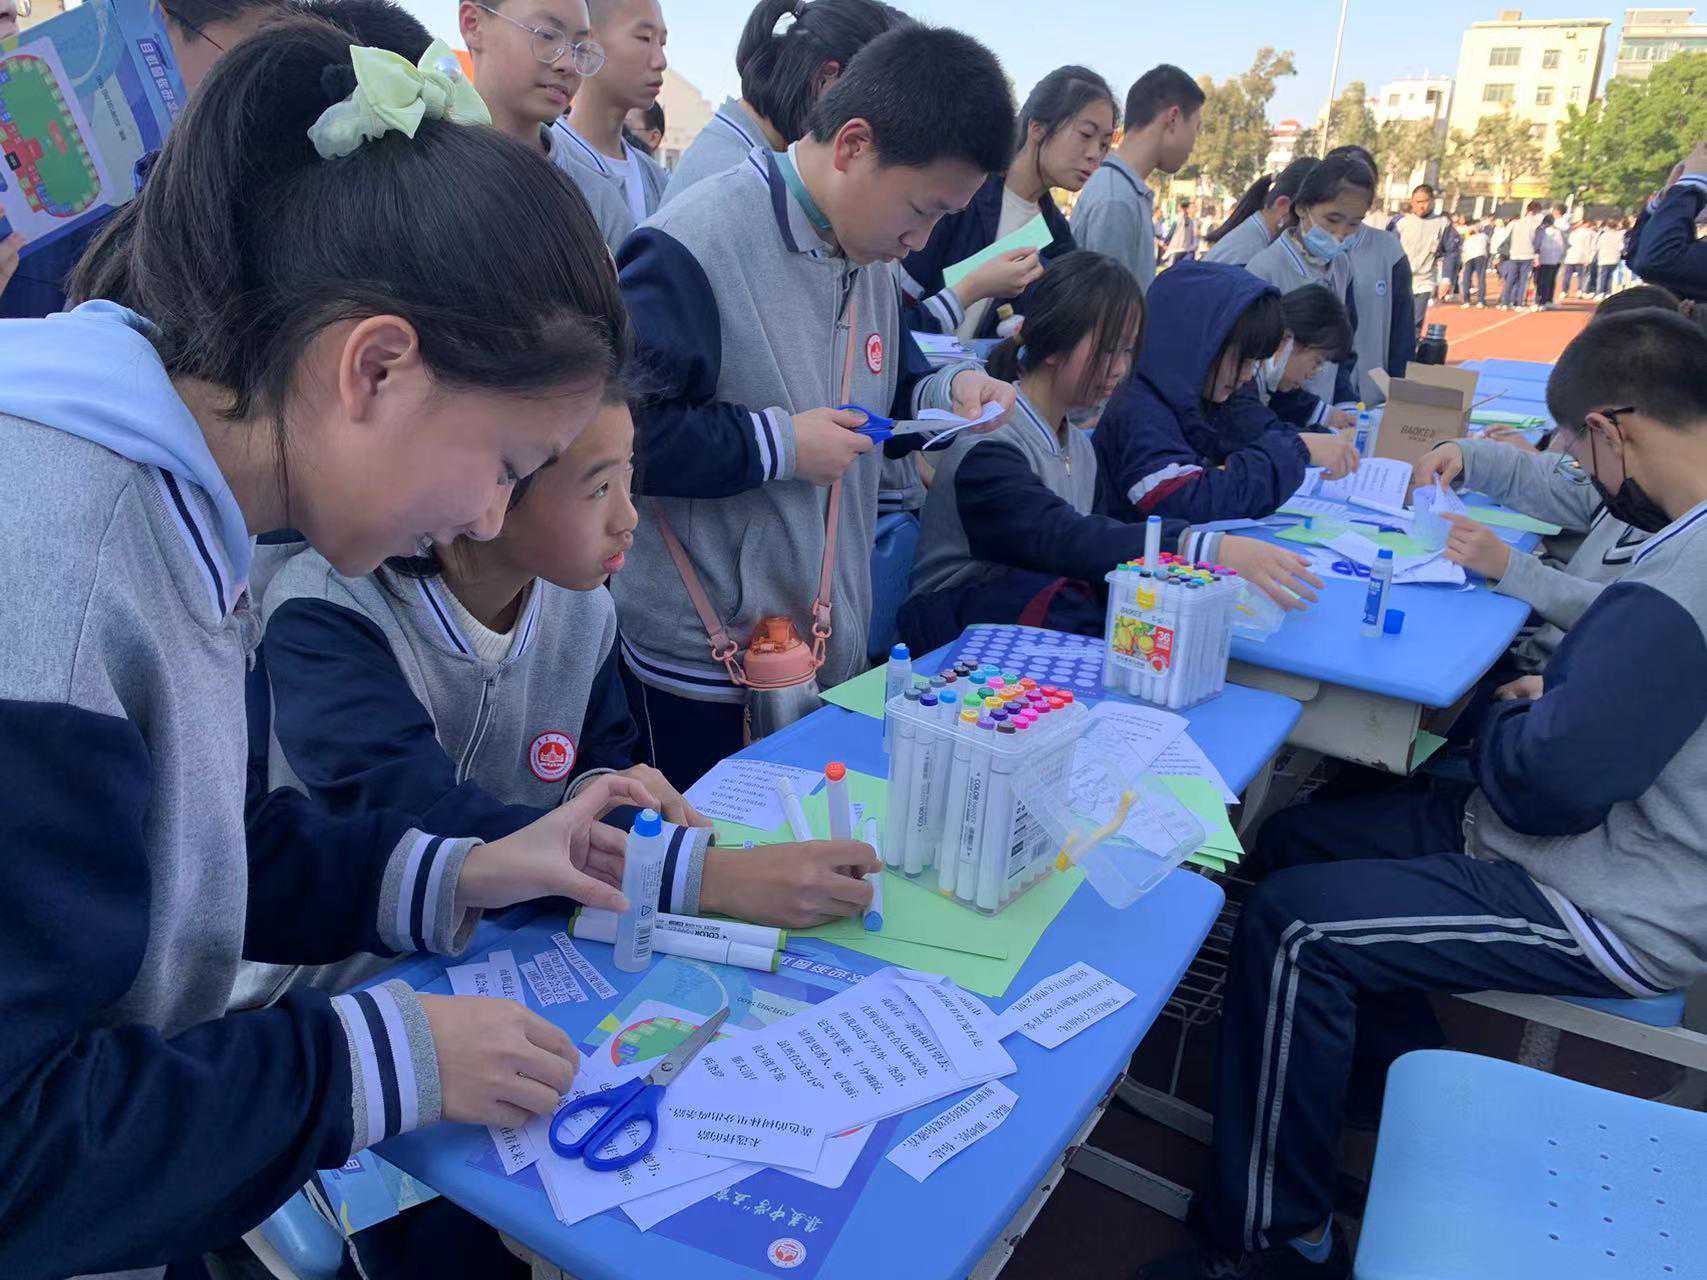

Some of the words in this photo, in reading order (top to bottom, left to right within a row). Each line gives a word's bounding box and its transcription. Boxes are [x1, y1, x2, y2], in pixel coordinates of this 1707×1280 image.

[694, 928, 721, 940] COLOR
[696, 1128, 764, 1149] 未选择的路
